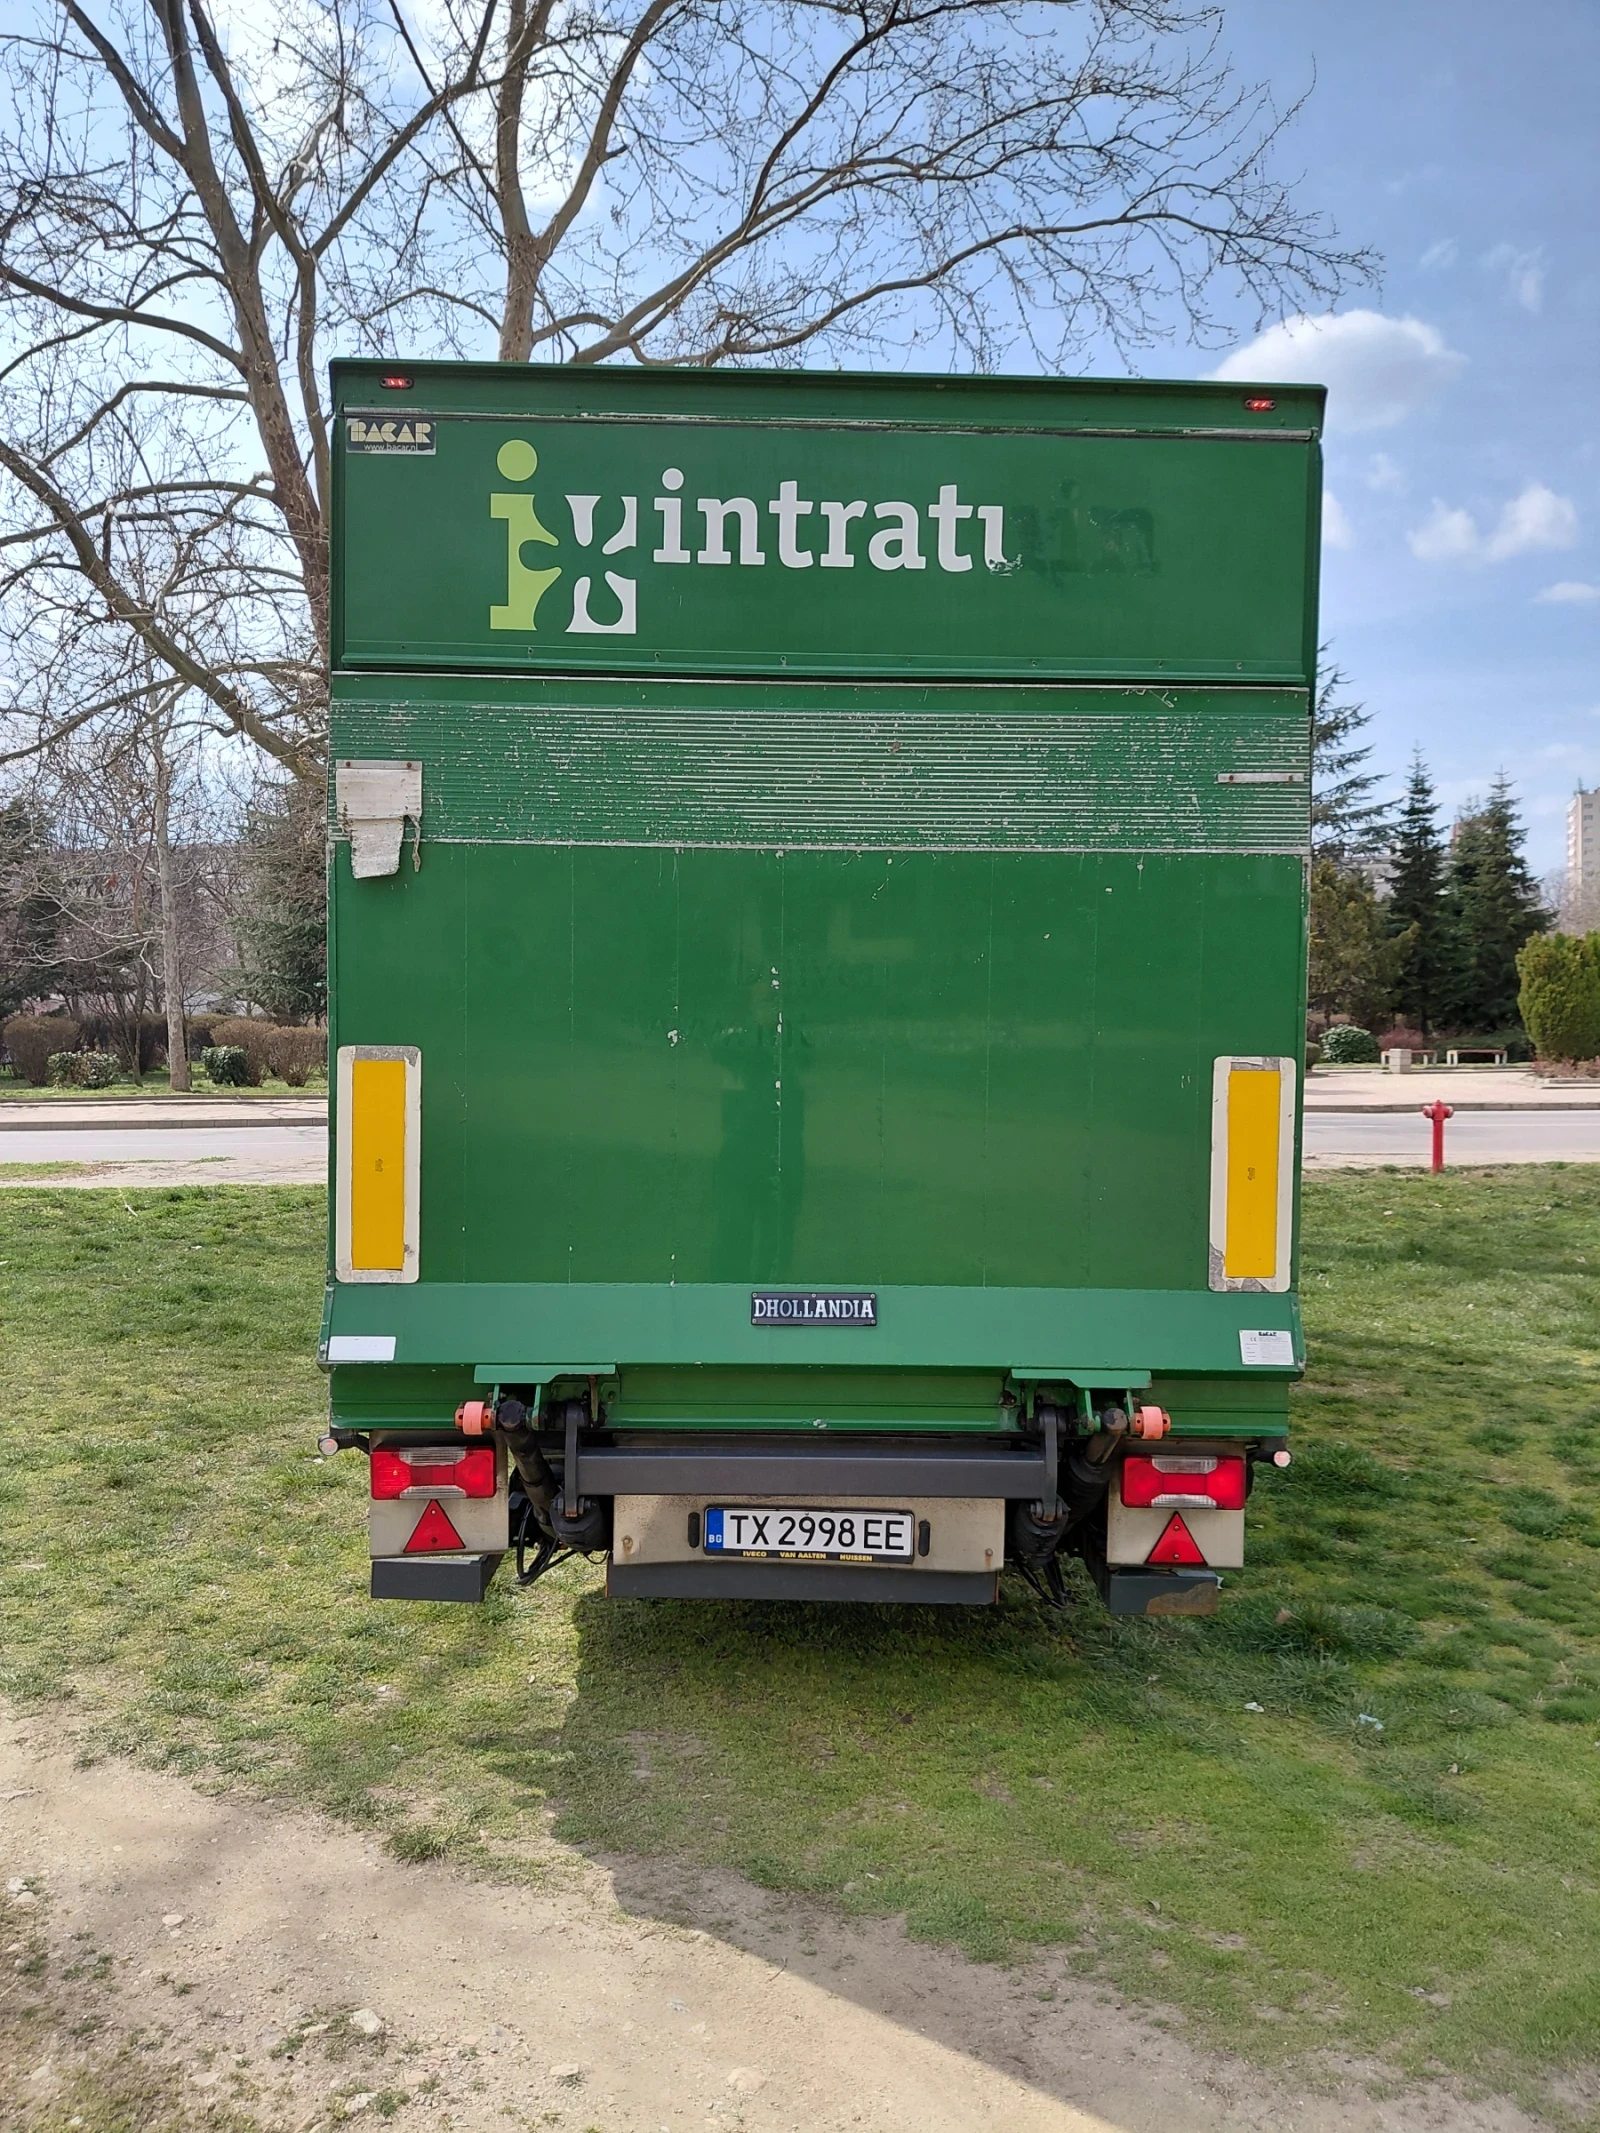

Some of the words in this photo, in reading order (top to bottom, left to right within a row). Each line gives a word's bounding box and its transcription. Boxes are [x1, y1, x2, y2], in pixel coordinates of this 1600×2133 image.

[350, 421, 431, 443] BACAR
[364, 443, 418, 452] www.bacar.nl
[754, 1299, 875, 1318] DHOLLANDIA
[708, 1534, 722, 1543] BG
[729, 1515, 770, 1546] TX
[778, 1517, 856, 1547] 2998
[863, 1520, 905, 1550] EE
[798, 1552, 827, 1560] AALTEN
